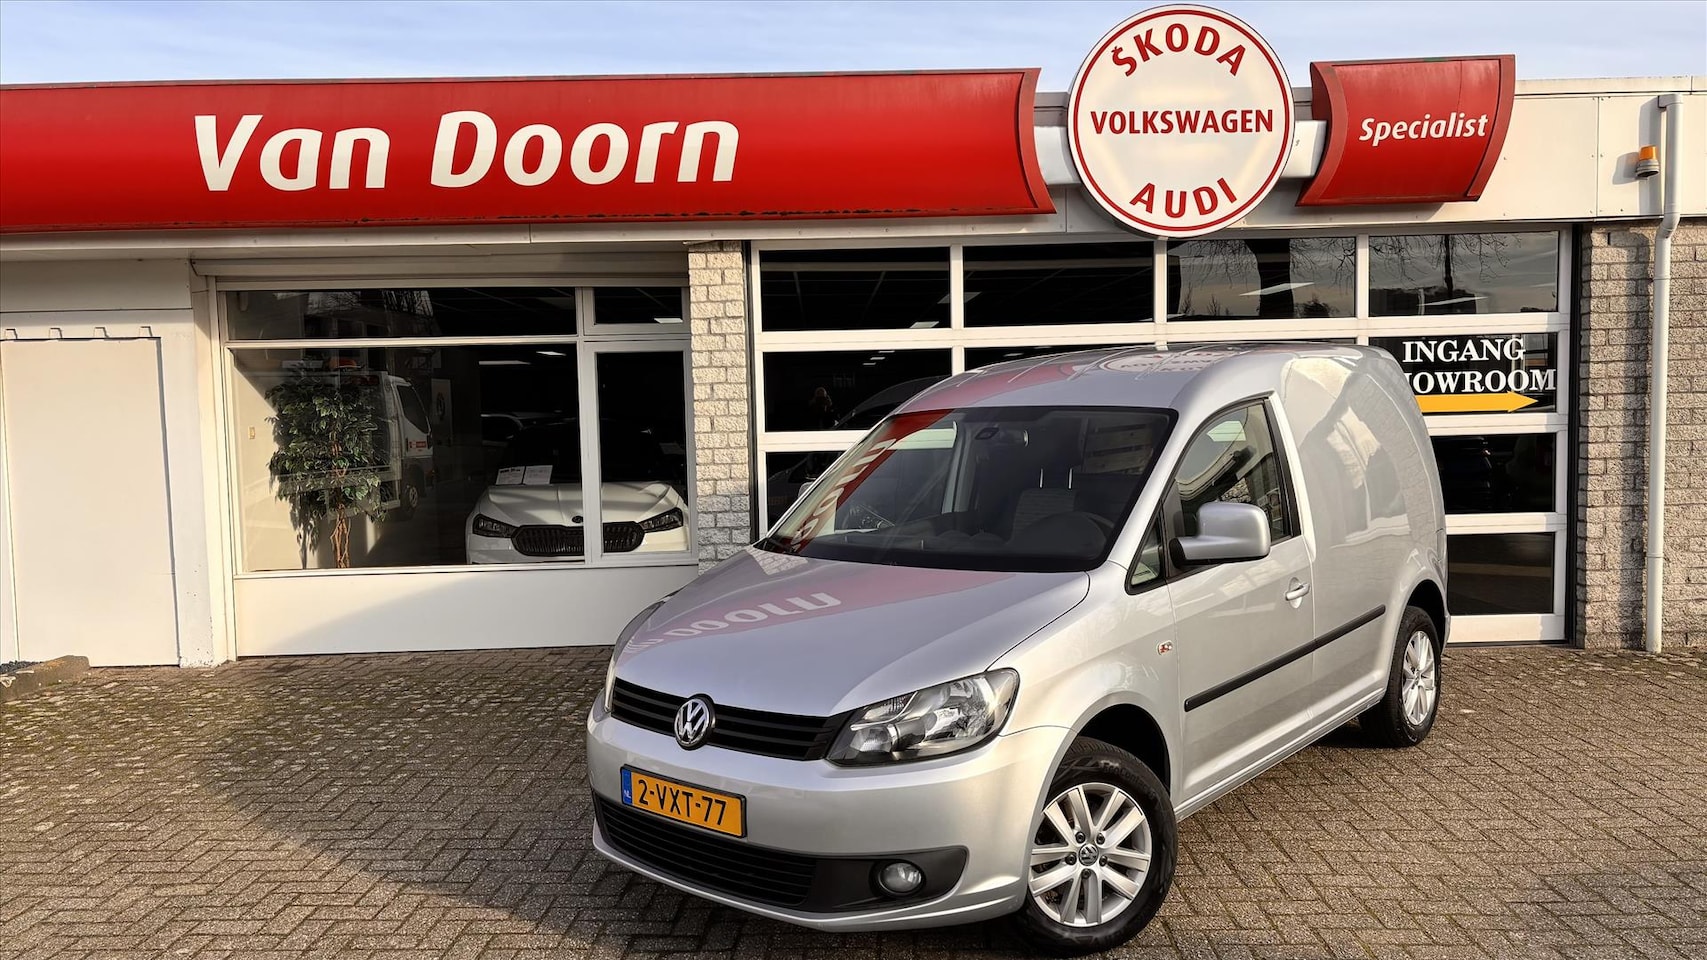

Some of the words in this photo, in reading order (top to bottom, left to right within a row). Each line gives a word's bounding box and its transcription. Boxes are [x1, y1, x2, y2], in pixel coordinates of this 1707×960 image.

[1111, 23, 1246, 77] ŠKODA
[1090, 109, 1273, 135] VOLKSWAGEN
[1358, 111, 1489, 147] Specialist
[194, 113, 391, 192] Van
[430, 110, 740, 189] Doorn
[1129, 177, 1238, 219] AUDI
[1402, 338, 1526, 363] INGANG
[1404, 368, 1557, 394] OWROOM
[638, 779, 727, 826] 2-VXT-77
